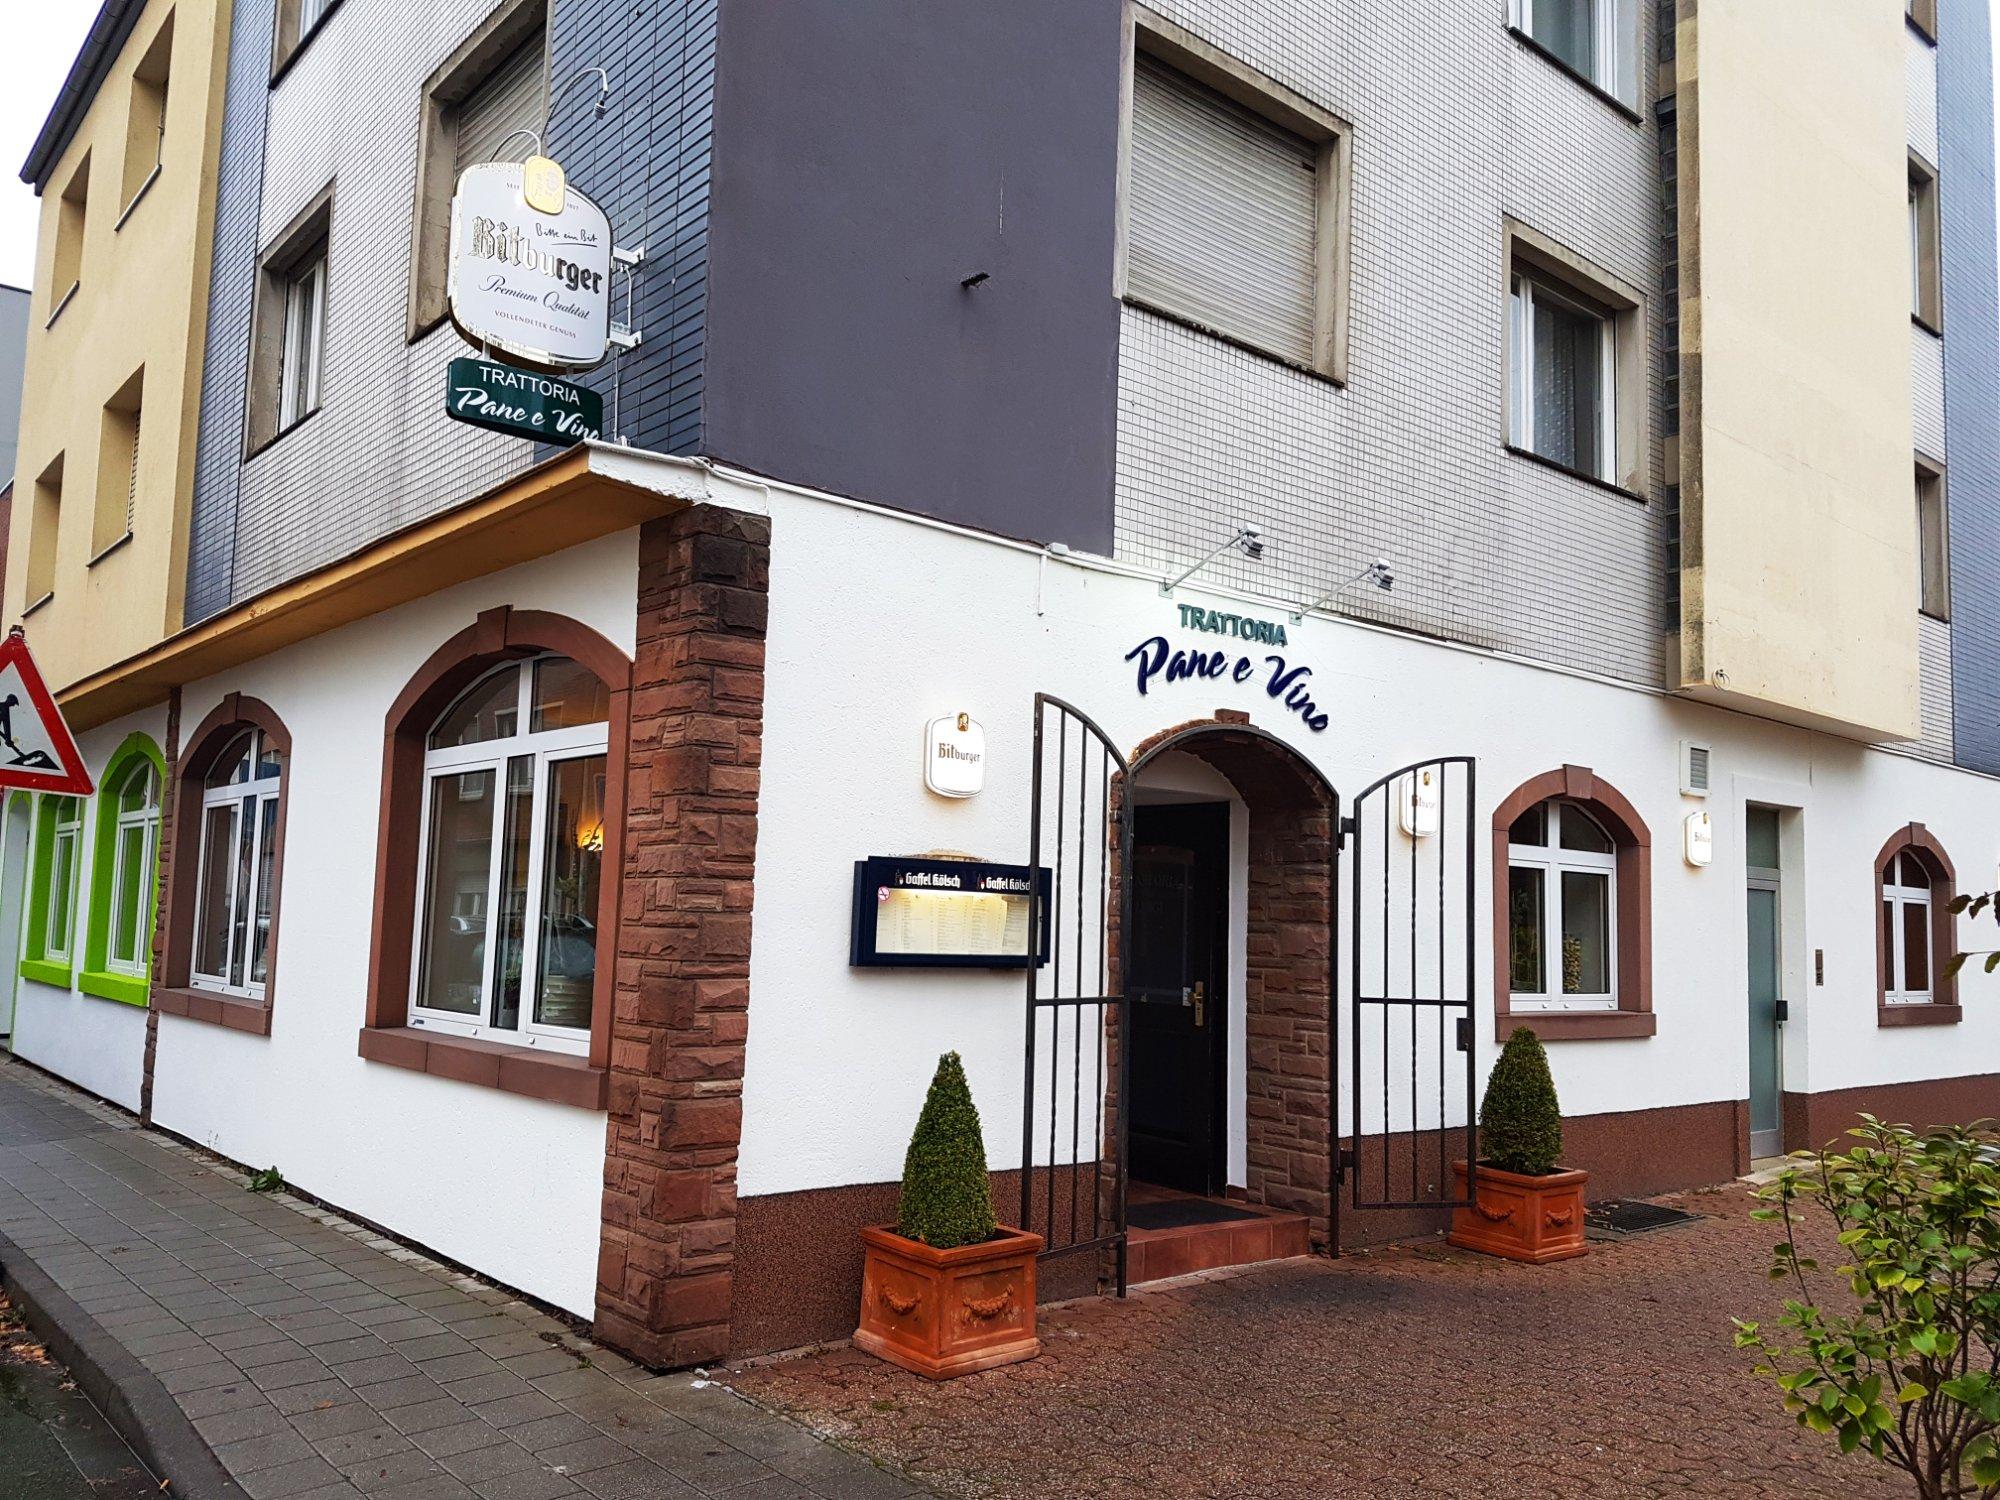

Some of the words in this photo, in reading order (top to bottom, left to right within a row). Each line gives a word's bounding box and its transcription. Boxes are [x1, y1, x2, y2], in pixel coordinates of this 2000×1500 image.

[535, 222, 560, 238] Bitte
[580, 229, 598, 242] Bit
[468, 215, 603, 295] Bitburger
[478, 274, 538, 303] Premium
[542, 291, 592, 321] Qualität
[494, 309, 548, 330] VOLLENDETER
[549, 324, 577, 340] GENUSS
[478, 366, 581, 406] TRATTORIA
[455, 387, 528, 422] Pane
[531, 412, 546, 426] e
[1177, 603, 1289, 648] TRATTORIA
[1124, 636, 1229, 696] Pane
[1232, 656, 1254, 683] e
[1265, 655, 1330, 732] Vino
[938, 742, 981, 764] Bitburger
[905, 871, 931, 886] Gaffel
[932, 873, 961, 889] Kölsch
[986, 876, 1009, 890] Gaffel
